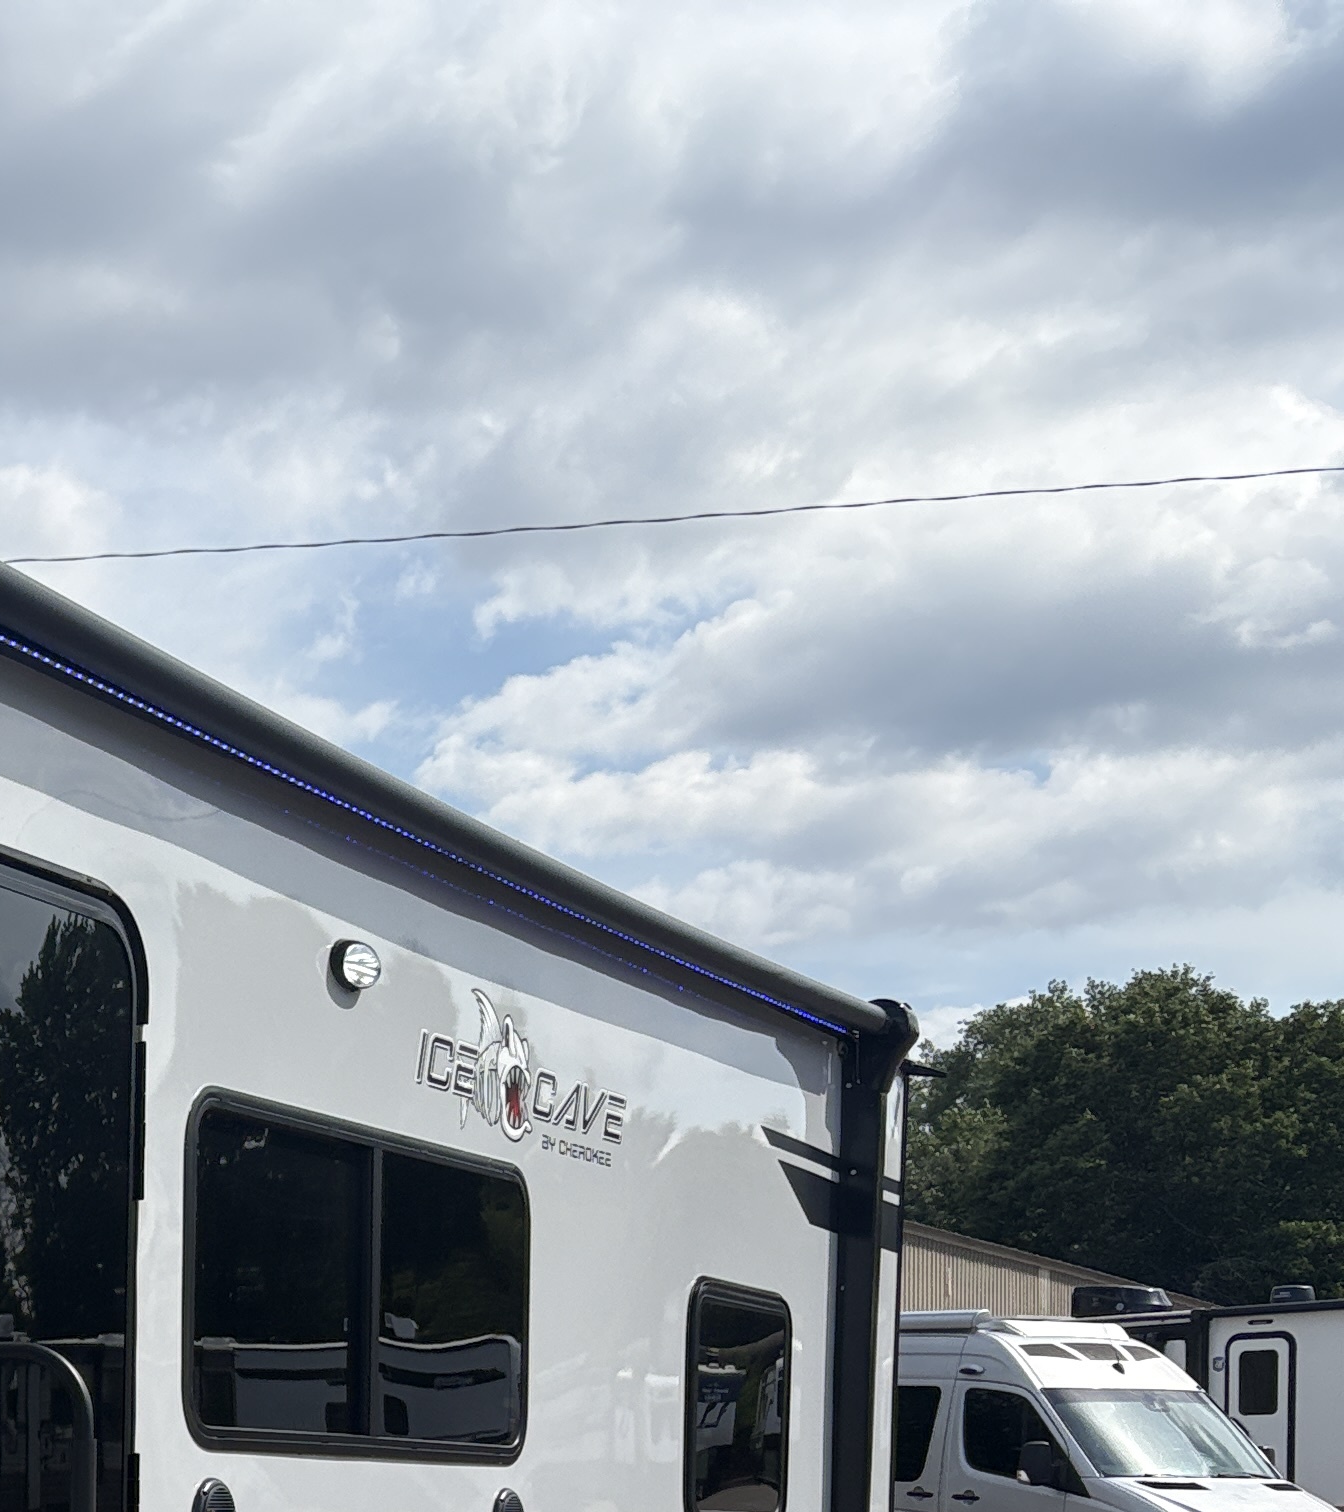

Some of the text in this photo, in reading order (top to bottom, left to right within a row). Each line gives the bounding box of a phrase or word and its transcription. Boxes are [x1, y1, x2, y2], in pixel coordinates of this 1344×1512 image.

[414, 1028, 628, 1145] ICE CAVE
[542, 1134, 611, 1167] BY CHEROKEE
